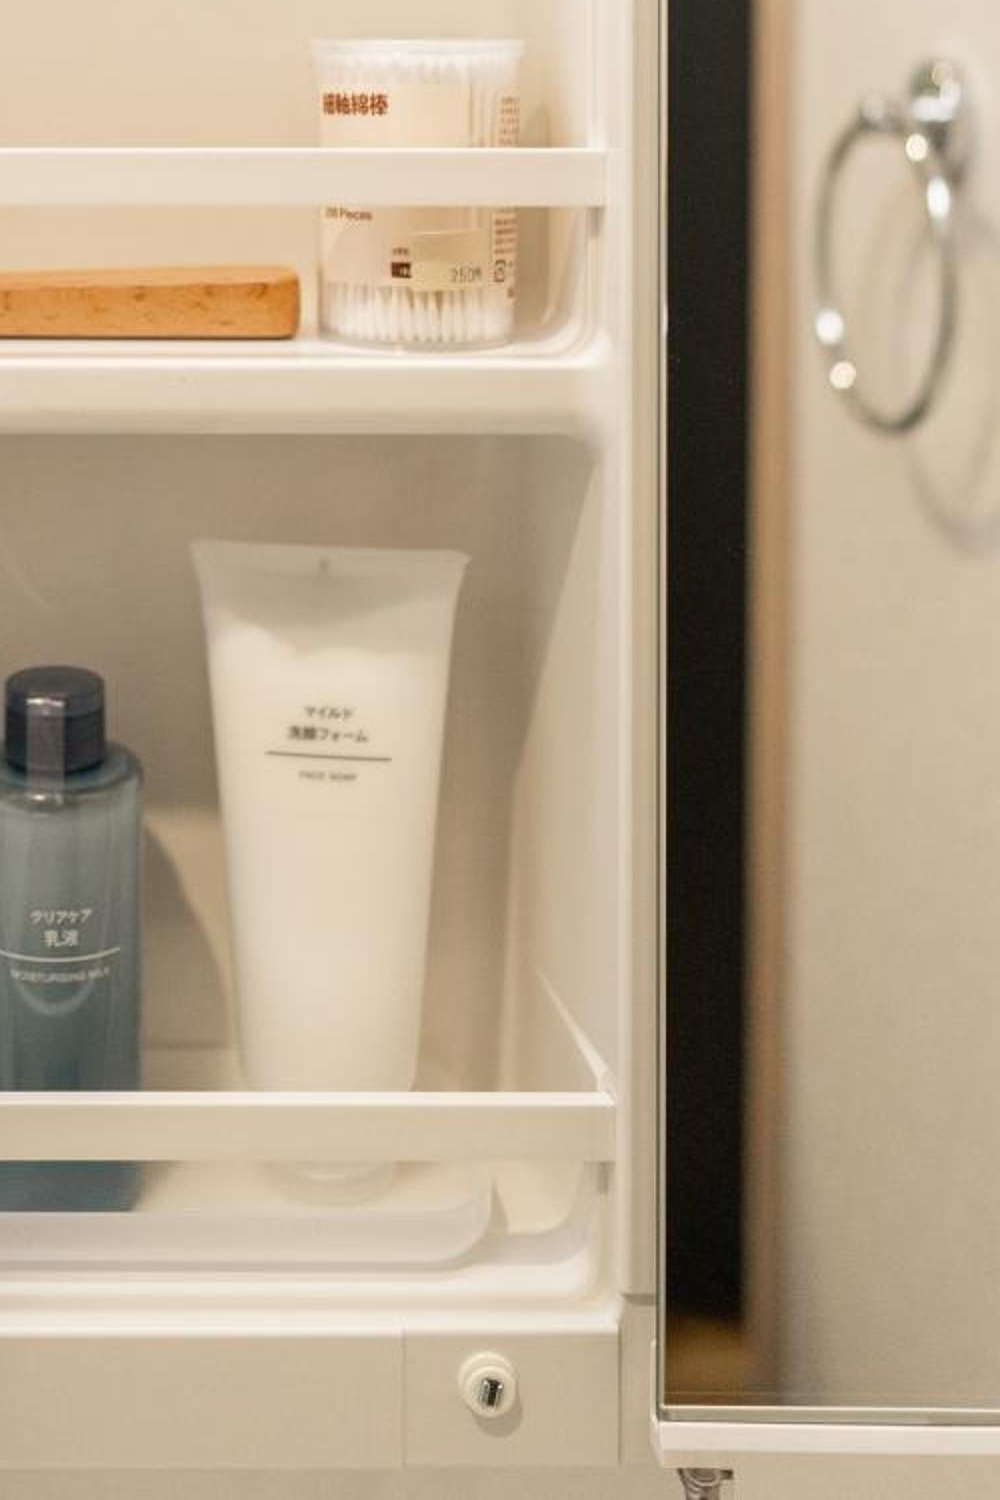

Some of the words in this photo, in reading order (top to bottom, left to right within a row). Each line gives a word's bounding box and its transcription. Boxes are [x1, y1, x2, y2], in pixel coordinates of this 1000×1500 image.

[29, 908, 93, 924] クリアケア
[43, 930, 79, 948] 乳液
